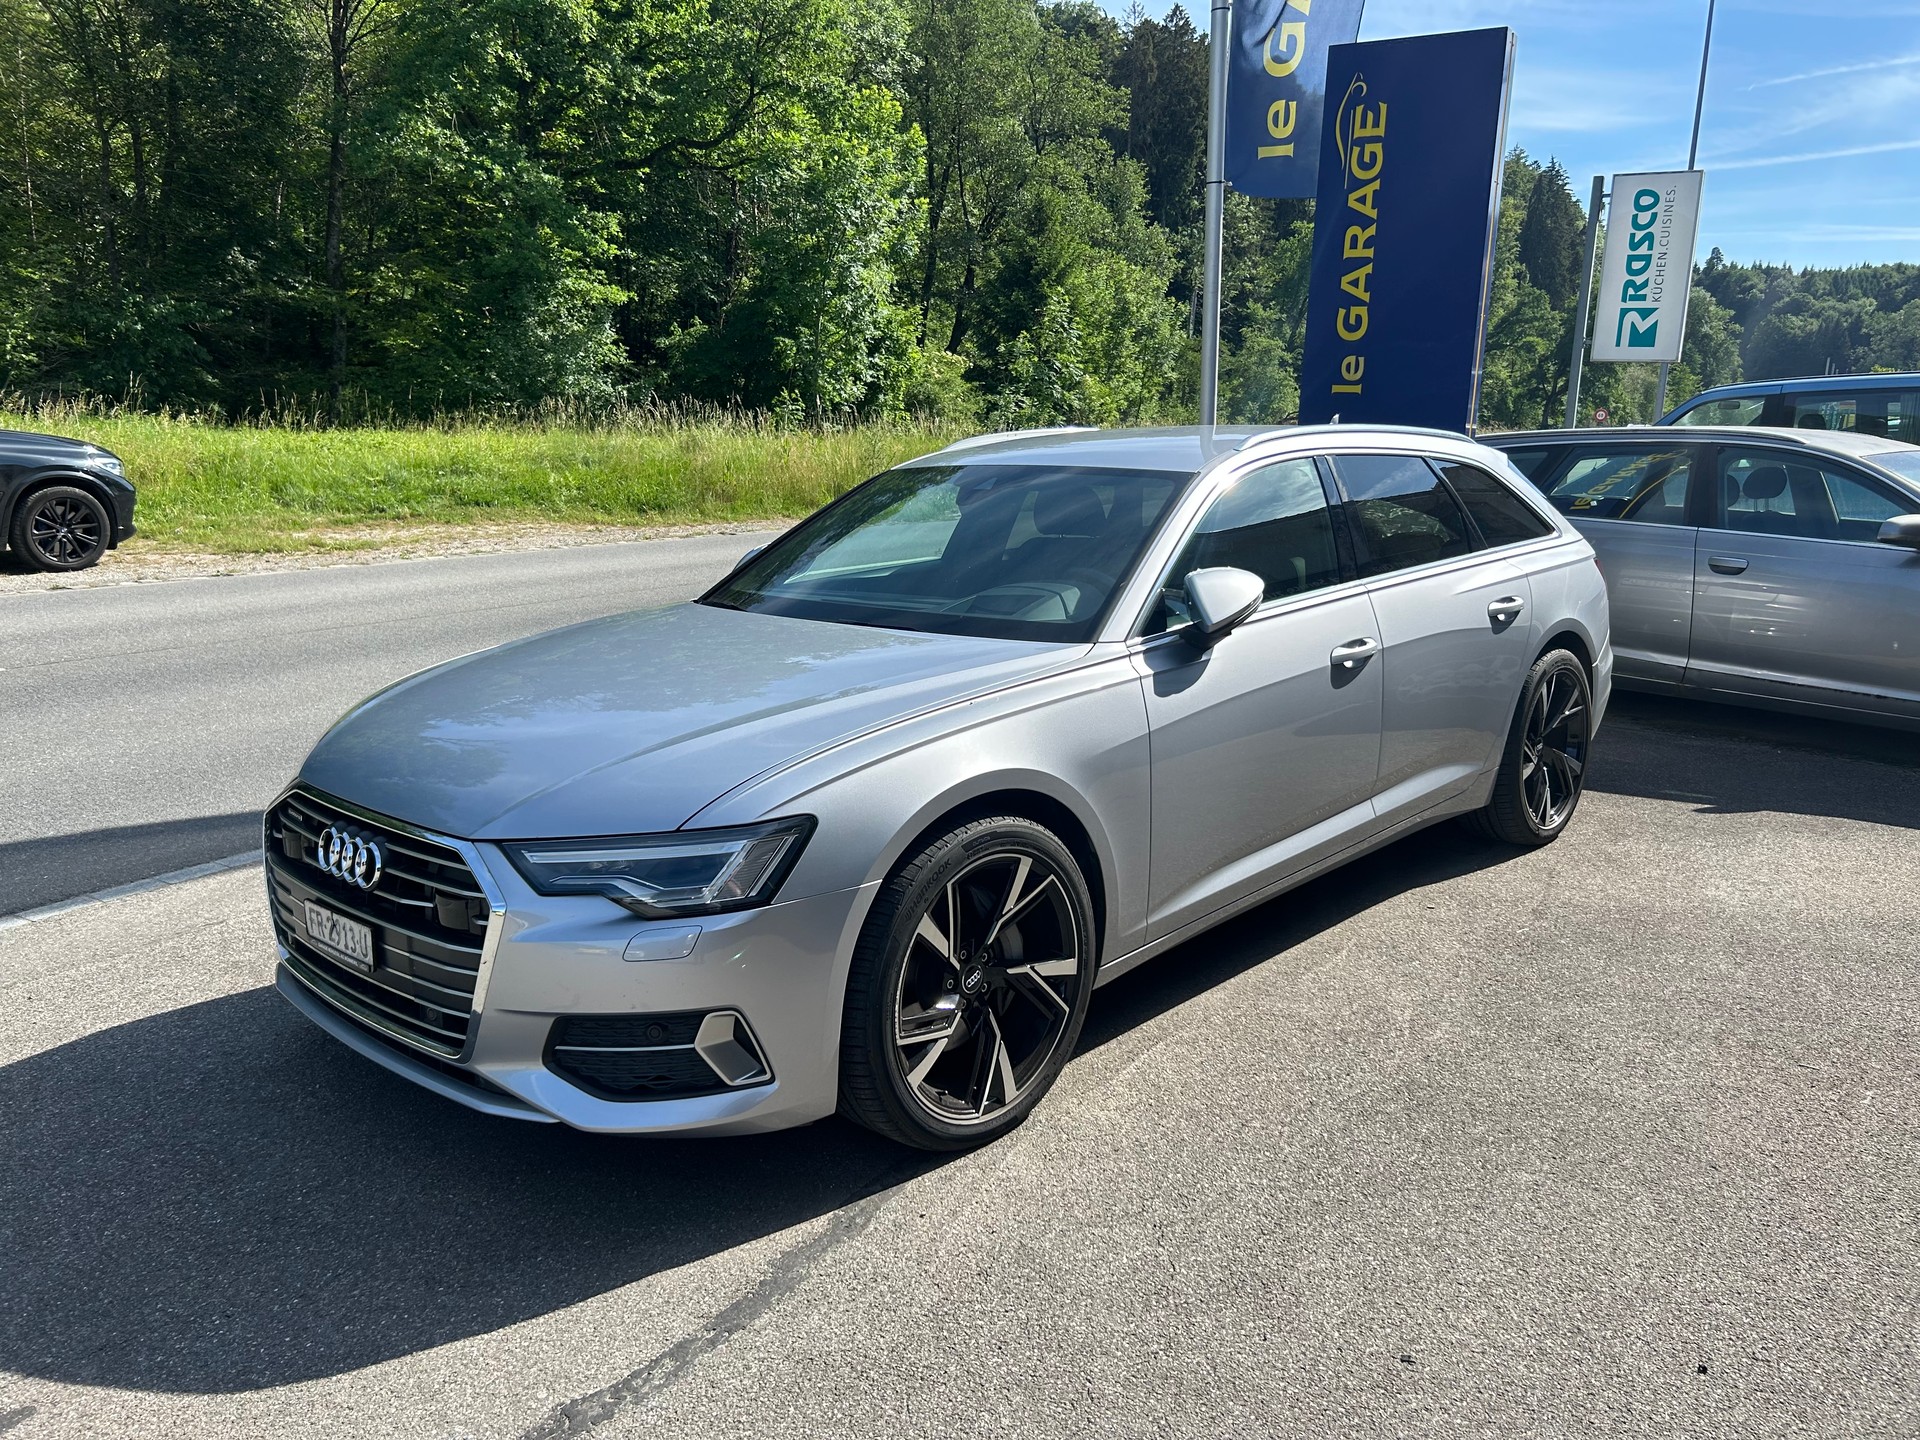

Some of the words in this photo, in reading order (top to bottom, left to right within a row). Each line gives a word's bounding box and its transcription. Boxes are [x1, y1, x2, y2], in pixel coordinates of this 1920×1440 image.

[1258, 100, 1297, 160] le
[1336, 102, 1388, 341] GARAGE
[1331, 355, 1365, 394] le
